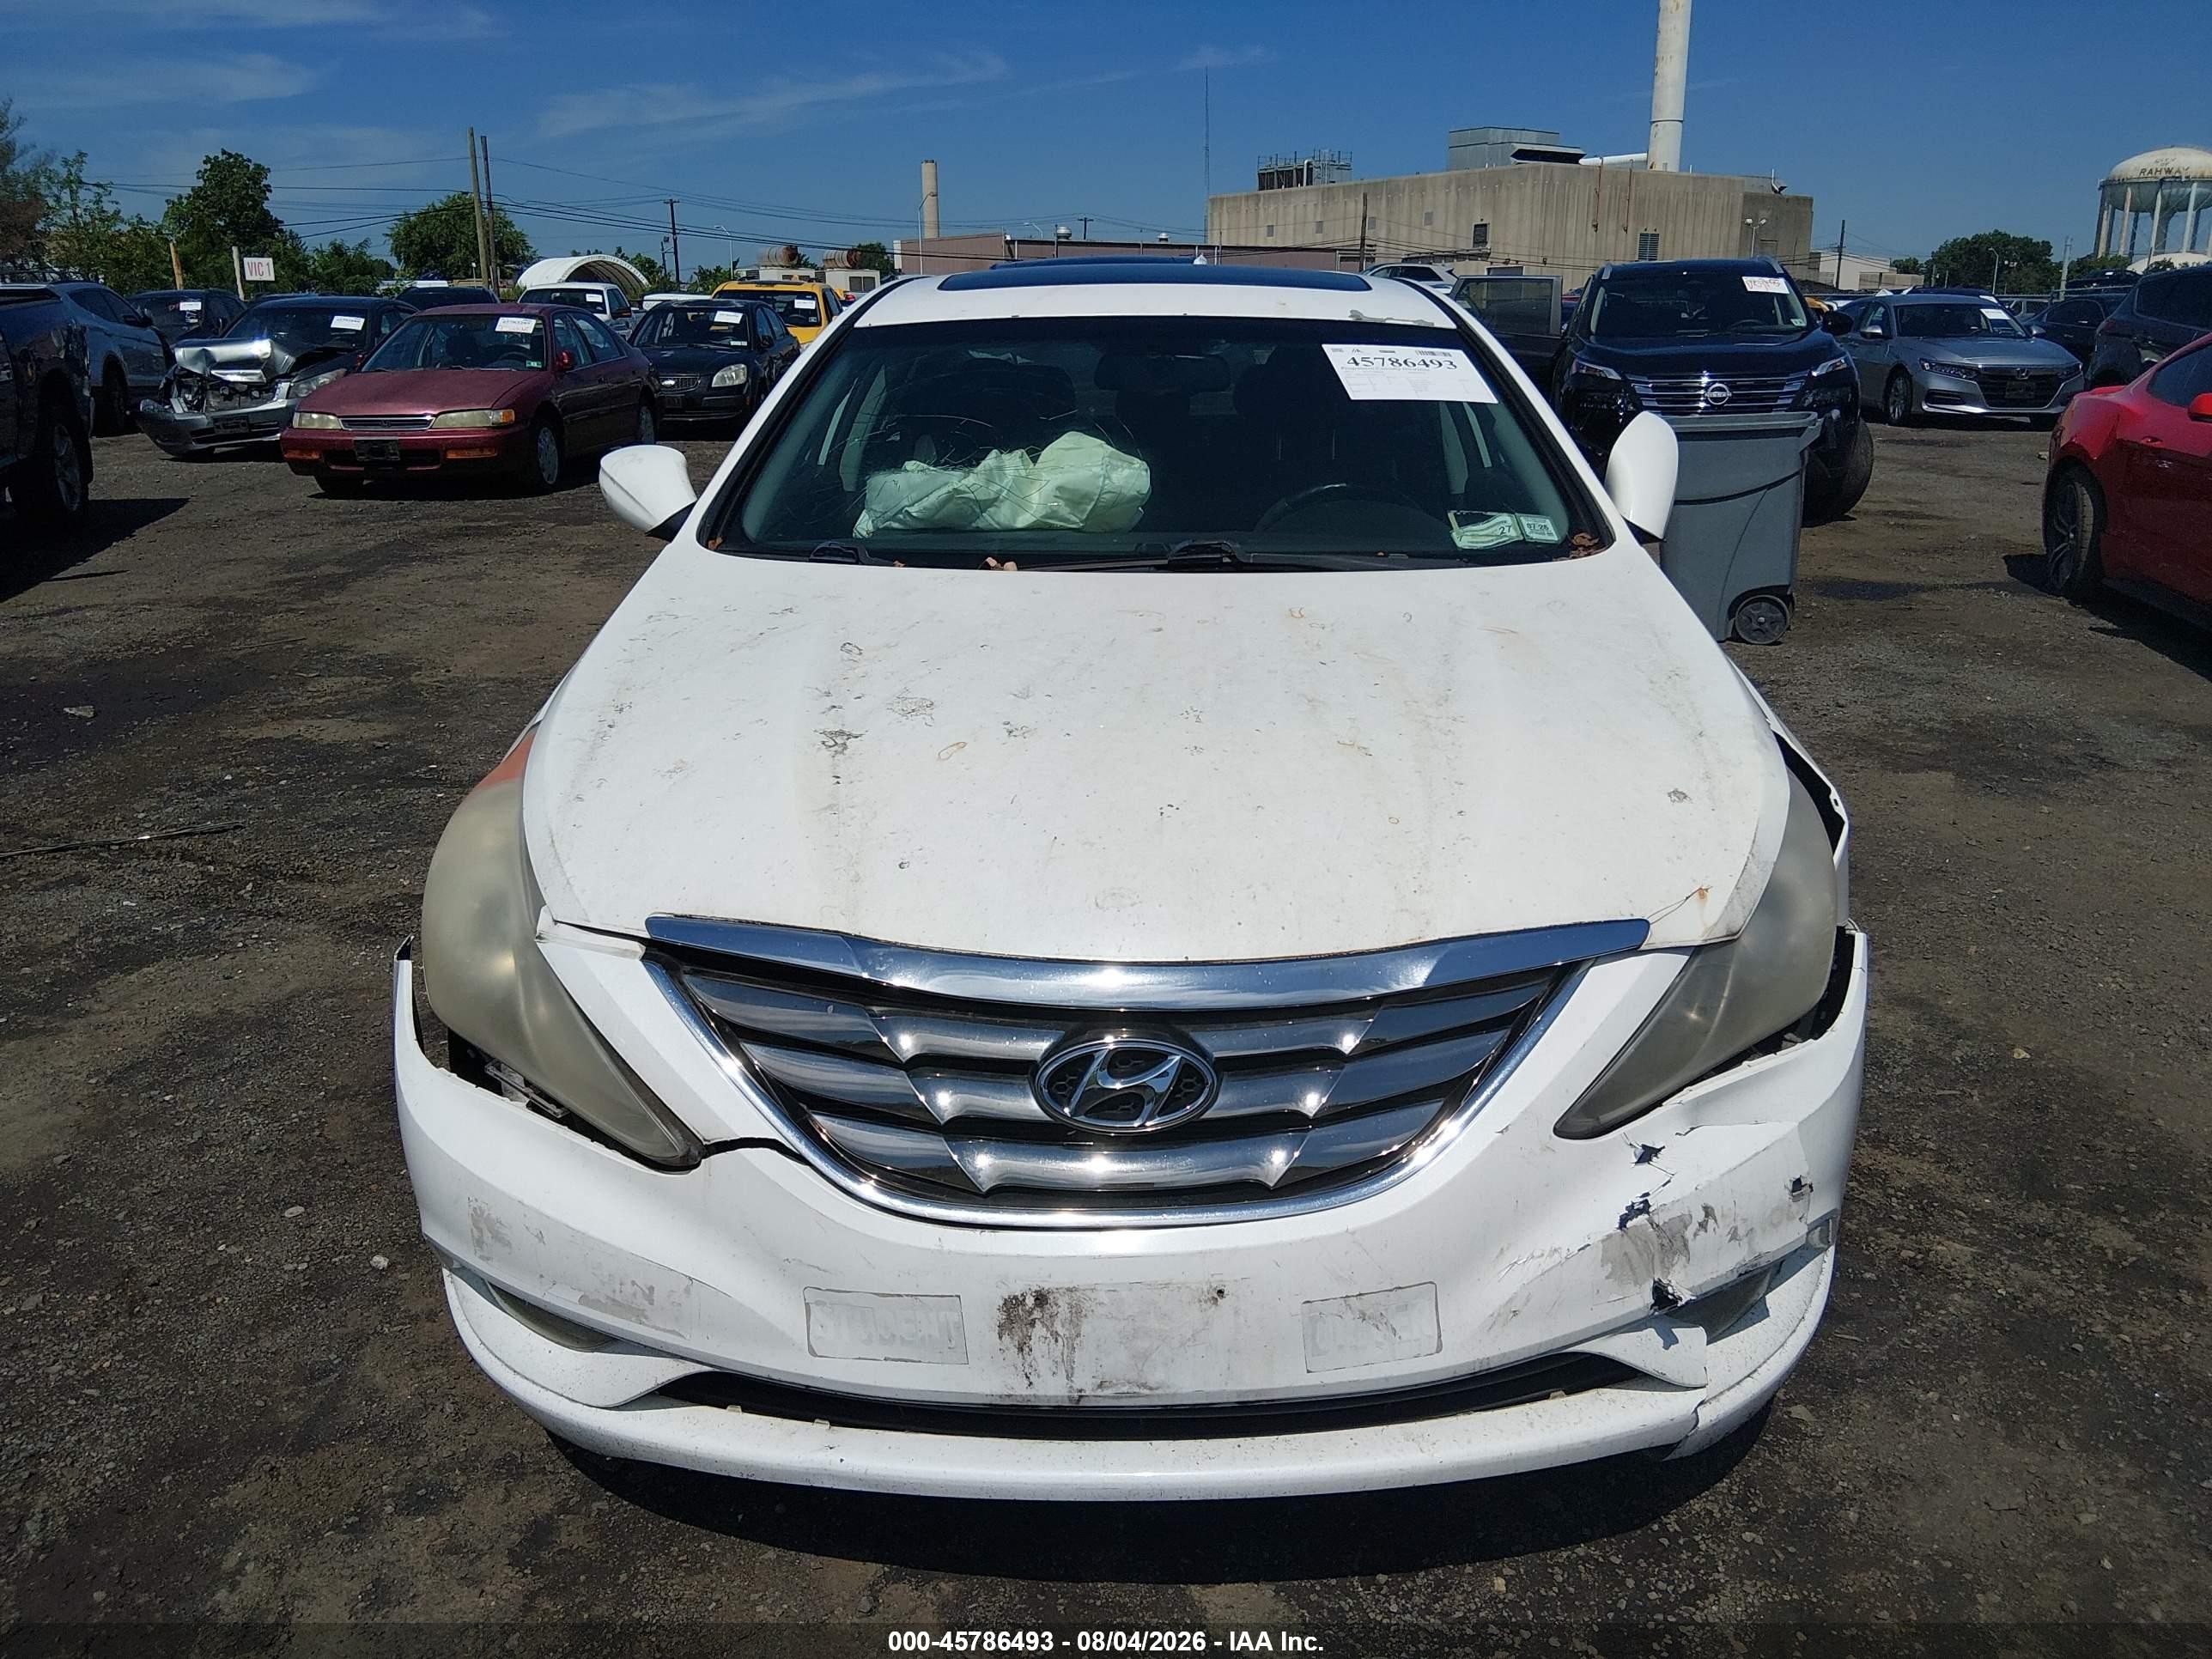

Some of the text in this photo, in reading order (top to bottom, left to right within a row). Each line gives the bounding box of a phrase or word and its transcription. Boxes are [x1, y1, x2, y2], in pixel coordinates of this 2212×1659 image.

[2139, 167, 2190, 176] RAHWAY
[247, 261, 271, 276] VIC 1
[1346, 356, 1457, 370] 45786493
[1498, 525, 1511, 536] 27
